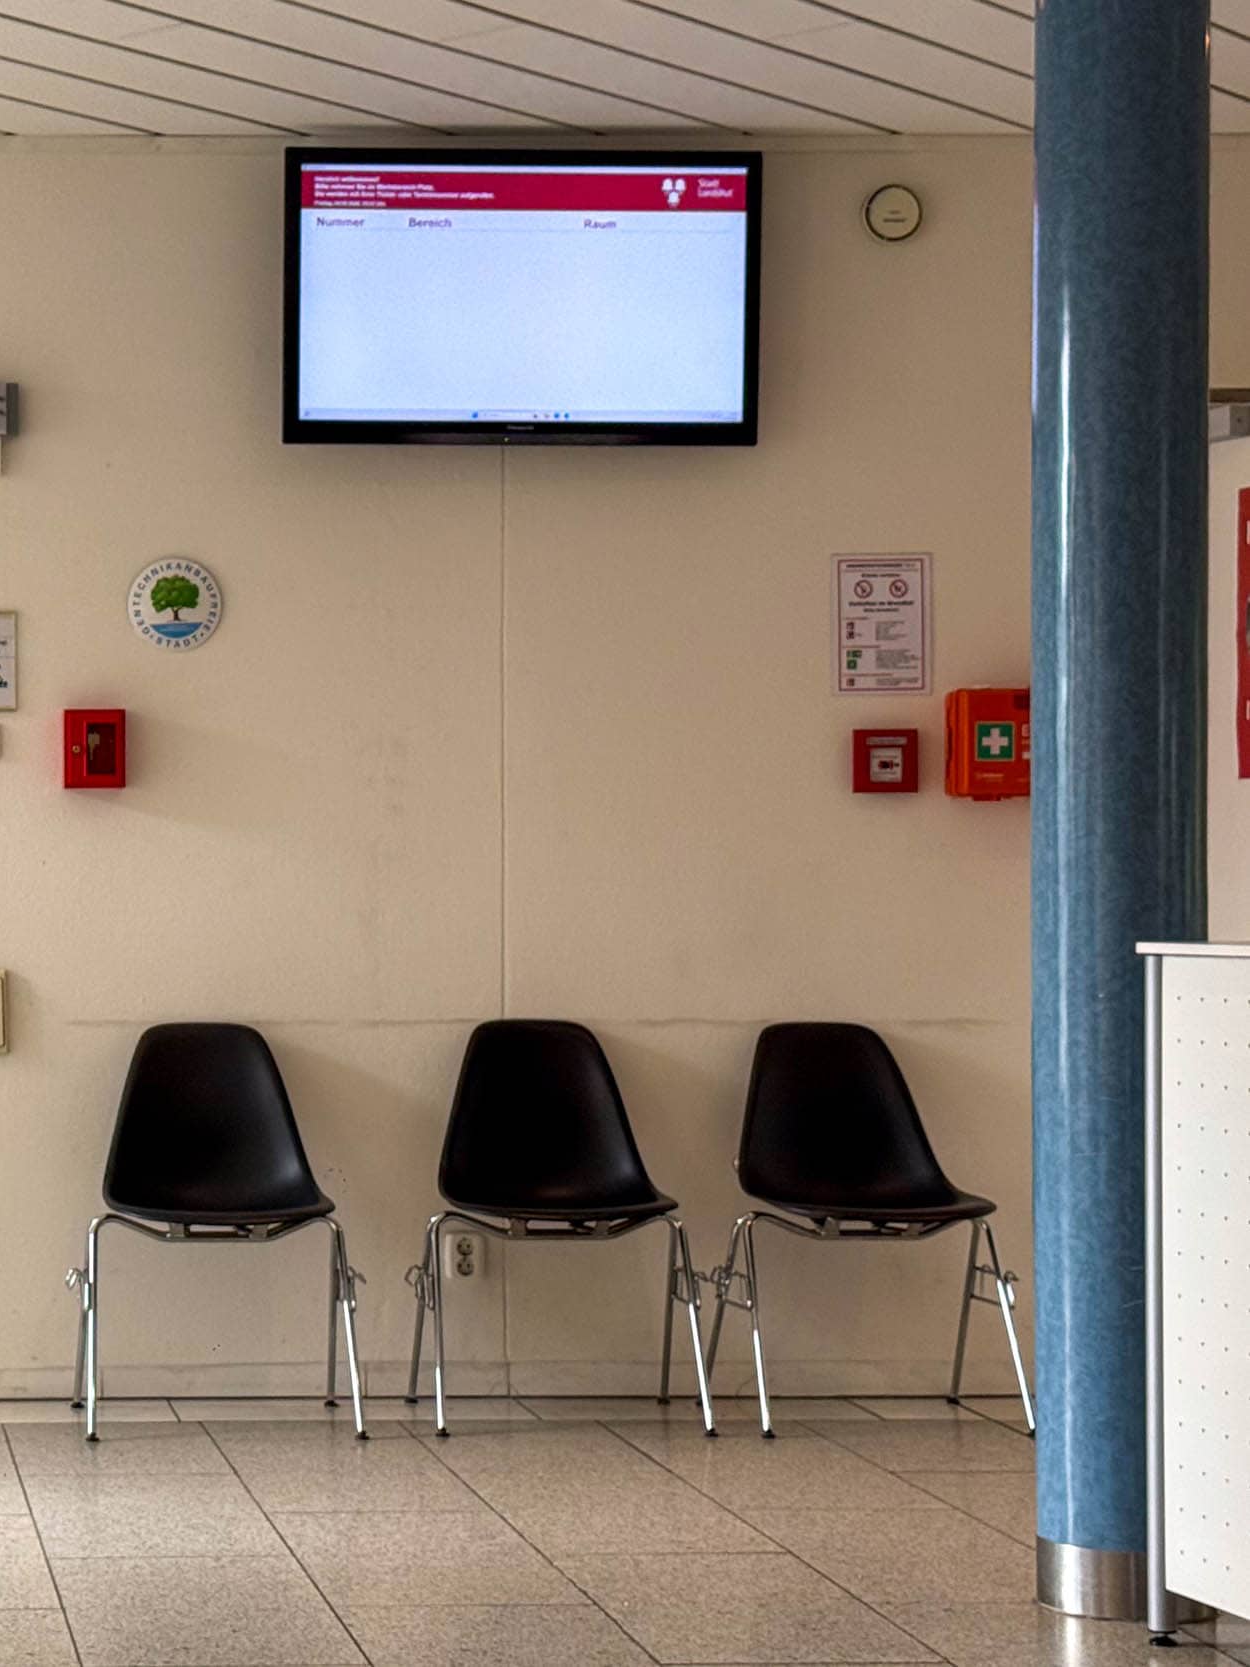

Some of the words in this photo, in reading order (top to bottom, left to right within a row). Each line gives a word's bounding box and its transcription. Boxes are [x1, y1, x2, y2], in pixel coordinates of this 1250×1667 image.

[316, 216, 365, 228] Nummer
[408, 216, 453, 228] Bereich
[583, 218, 617, 229] Raum
